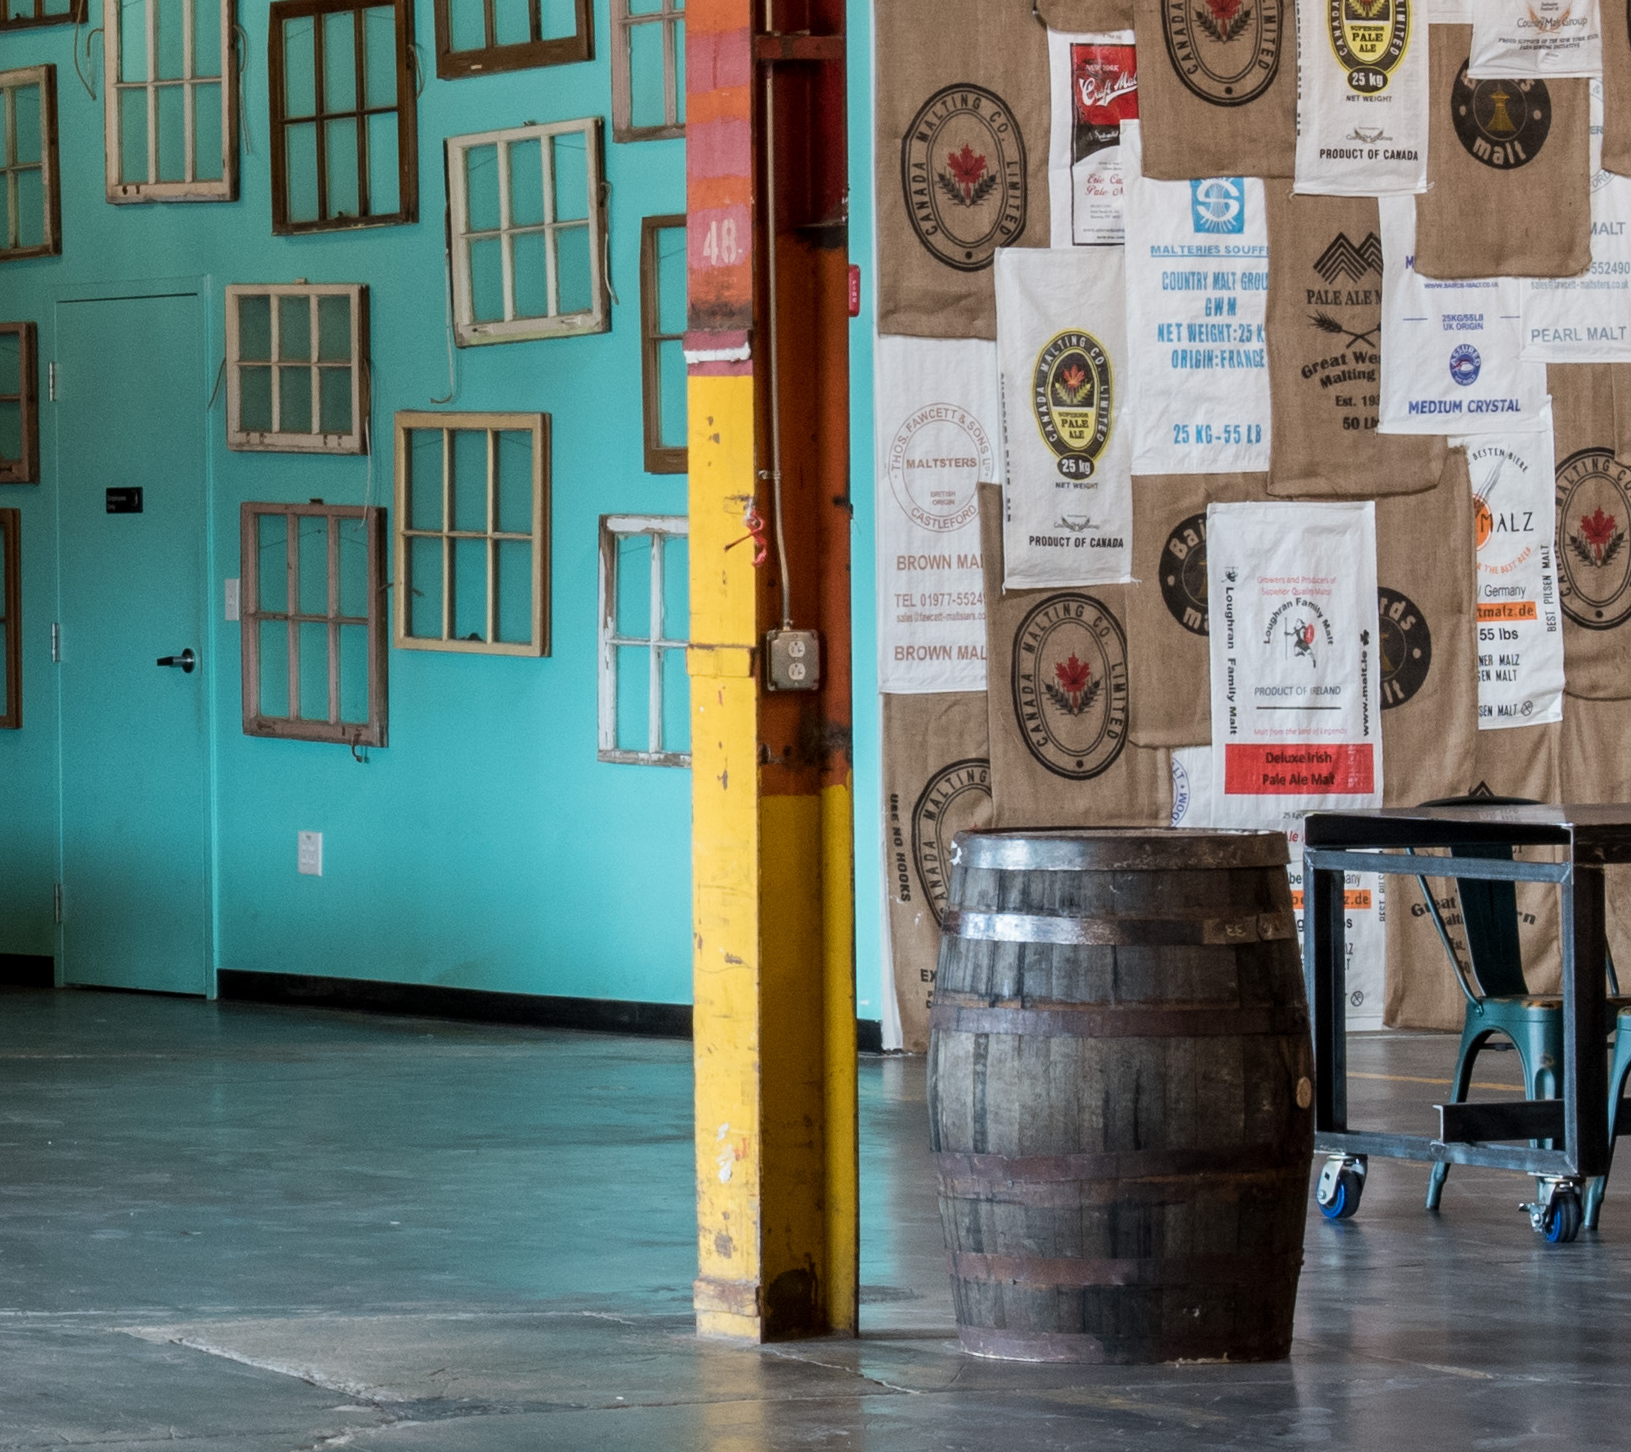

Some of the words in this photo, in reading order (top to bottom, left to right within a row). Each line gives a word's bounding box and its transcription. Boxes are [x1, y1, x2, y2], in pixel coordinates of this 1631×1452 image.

[1351, 72, 1366, 86] 25
[1368, 72, 1384, 88] kg
[916, 95, 982, 146] MALTING
[1319, 148, 1364, 161] PRODUCT
[1367, 149, 1381, 161] OF
[1383, 149, 1419, 161] CANADA
[910, 160, 938, 238] CANADA
[998, 160, 1021, 237] LIMITED
[1151, 245, 1221, 254] MALTERIES
[1162, 271, 1208, 290] COUNTRY
[1212, 272, 1236, 290] MALT
[1158, 323, 1183, 342] NET
[1530, 328, 1583, 342] PEARL
[1586, 327, 1627, 341] MALT
[1061, 419, 1089, 429] PALE
[890, 434, 910, 470] THOS.
[905, 408, 956, 440] FAWCETT
[958, 414, 967, 424] &
[965, 418, 991, 453] SONS
[1068, 429, 1085, 439] ALE
[1173, 424, 1192, 444] 25
[1246, 424, 1262, 444] LB
[906, 457, 977, 469] MALTSTERS
[1062, 459, 1077, 473] 25
[1078, 459, 1091, 474] kg
[910, 505, 977, 530] CASTLEFORD
[1029, 536, 1070, 548] PRODUCT
[1074, 537, 1087, 548] OF
[1090, 537, 1124, 548] CANADA
[1024, 602, 1084, 653] MALTING
[1225, 587, 1235, 649] Loughran
[1264, 601, 1293, 644] Loughran
[1296, 597, 1323, 618] Family
[1322, 619, 1334, 645] Malt
[894, 646, 953, 661] BROWN
[1227, 658, 1236, 702] Family
[1254, 687, 1293, 695] PRODUCT
[1296, 687, 1307, 695] OF
[1360, 651, 1370, 736] www.malt.ie
[1024, 672, 1049, 747] CANADA
[1104, 661, 1125, 741] LIMITED
[1229, 707, 1237, 735] Malt
[1265, 751, 1304, 765] Deluxe
[1306, 751, 1333, 765] Irish
[1262, 772, 1287, 786] Pale
[1289, 773, 1309, 786] Ale
[1310, 772, 1335, 786] Malt
